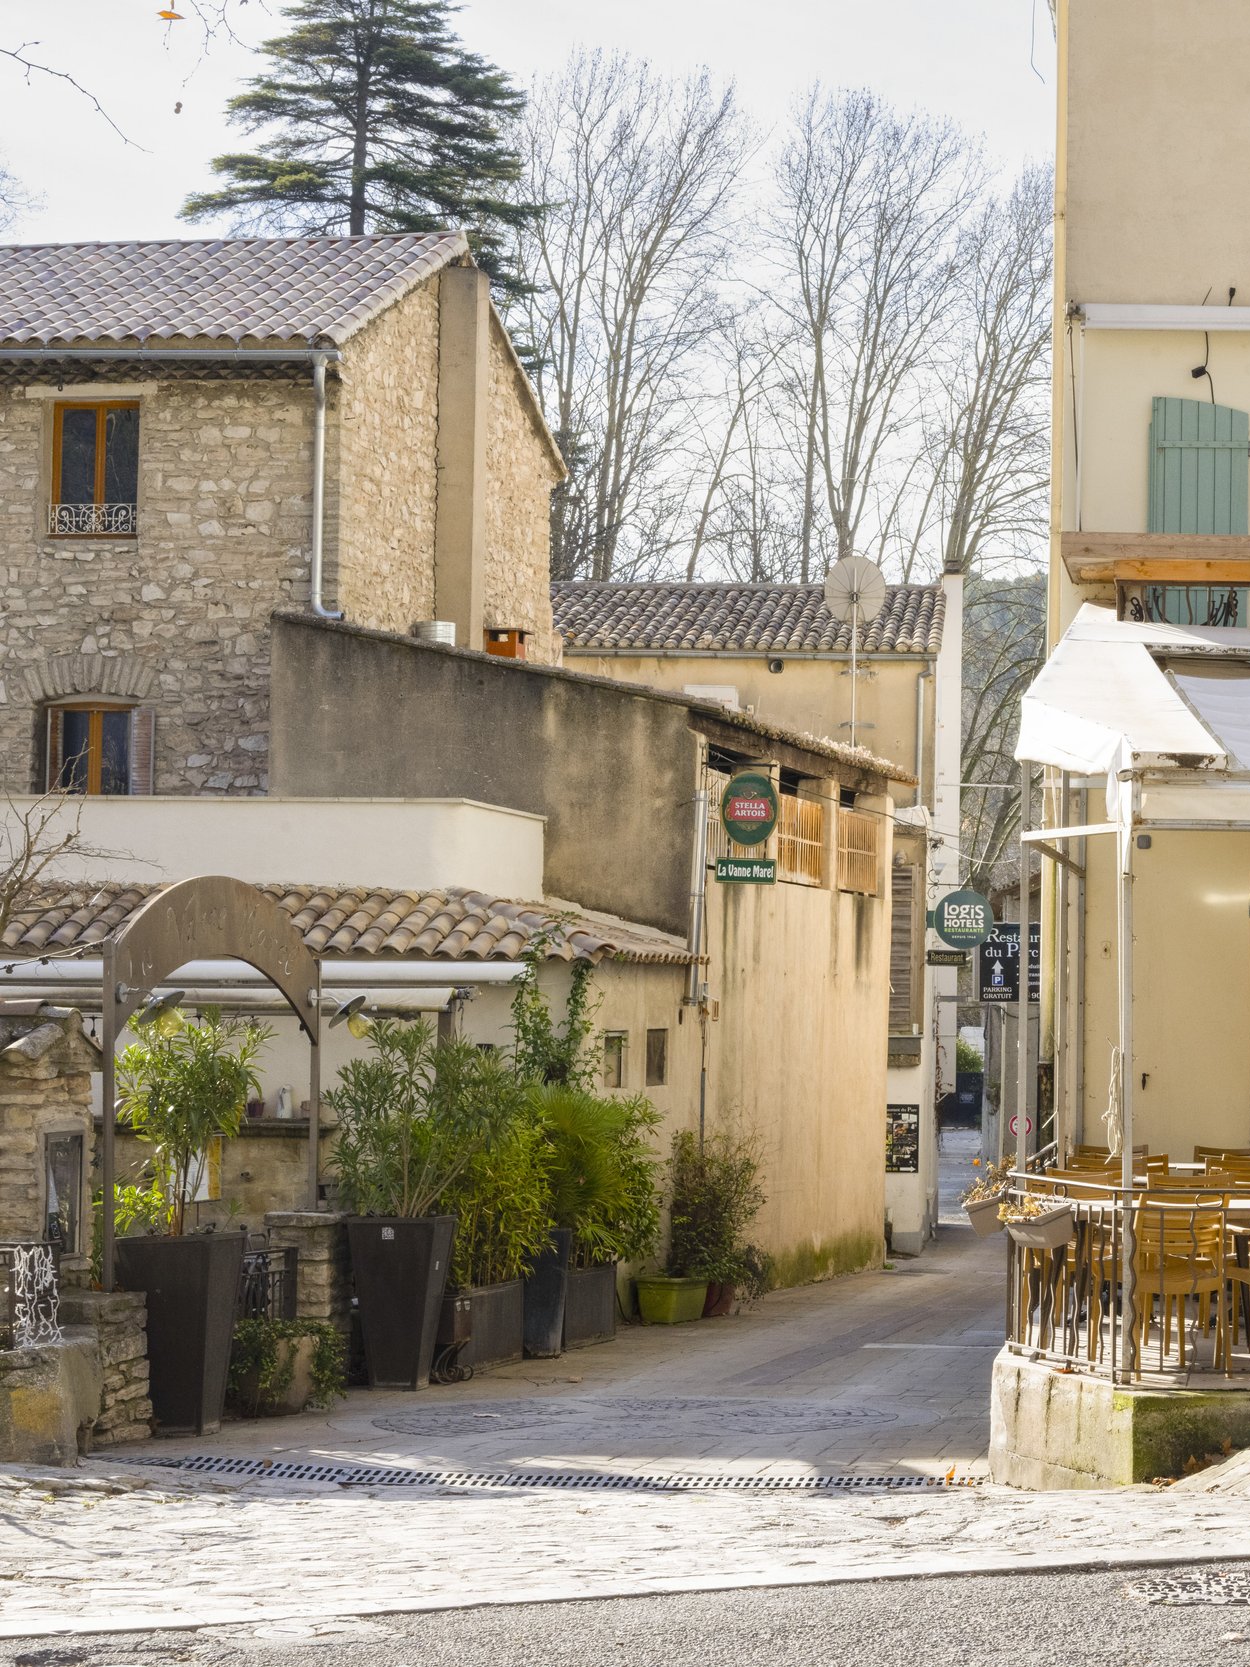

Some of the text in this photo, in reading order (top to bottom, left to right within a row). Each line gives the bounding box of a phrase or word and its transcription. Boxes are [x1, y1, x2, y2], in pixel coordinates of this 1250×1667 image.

[718, 864, 773, 878] La Vanne Marel
[944, 919, 985, 928] HOTELS
[930, 952, 964, 962] Restaurant
[985, 946, 1002, 958] du
